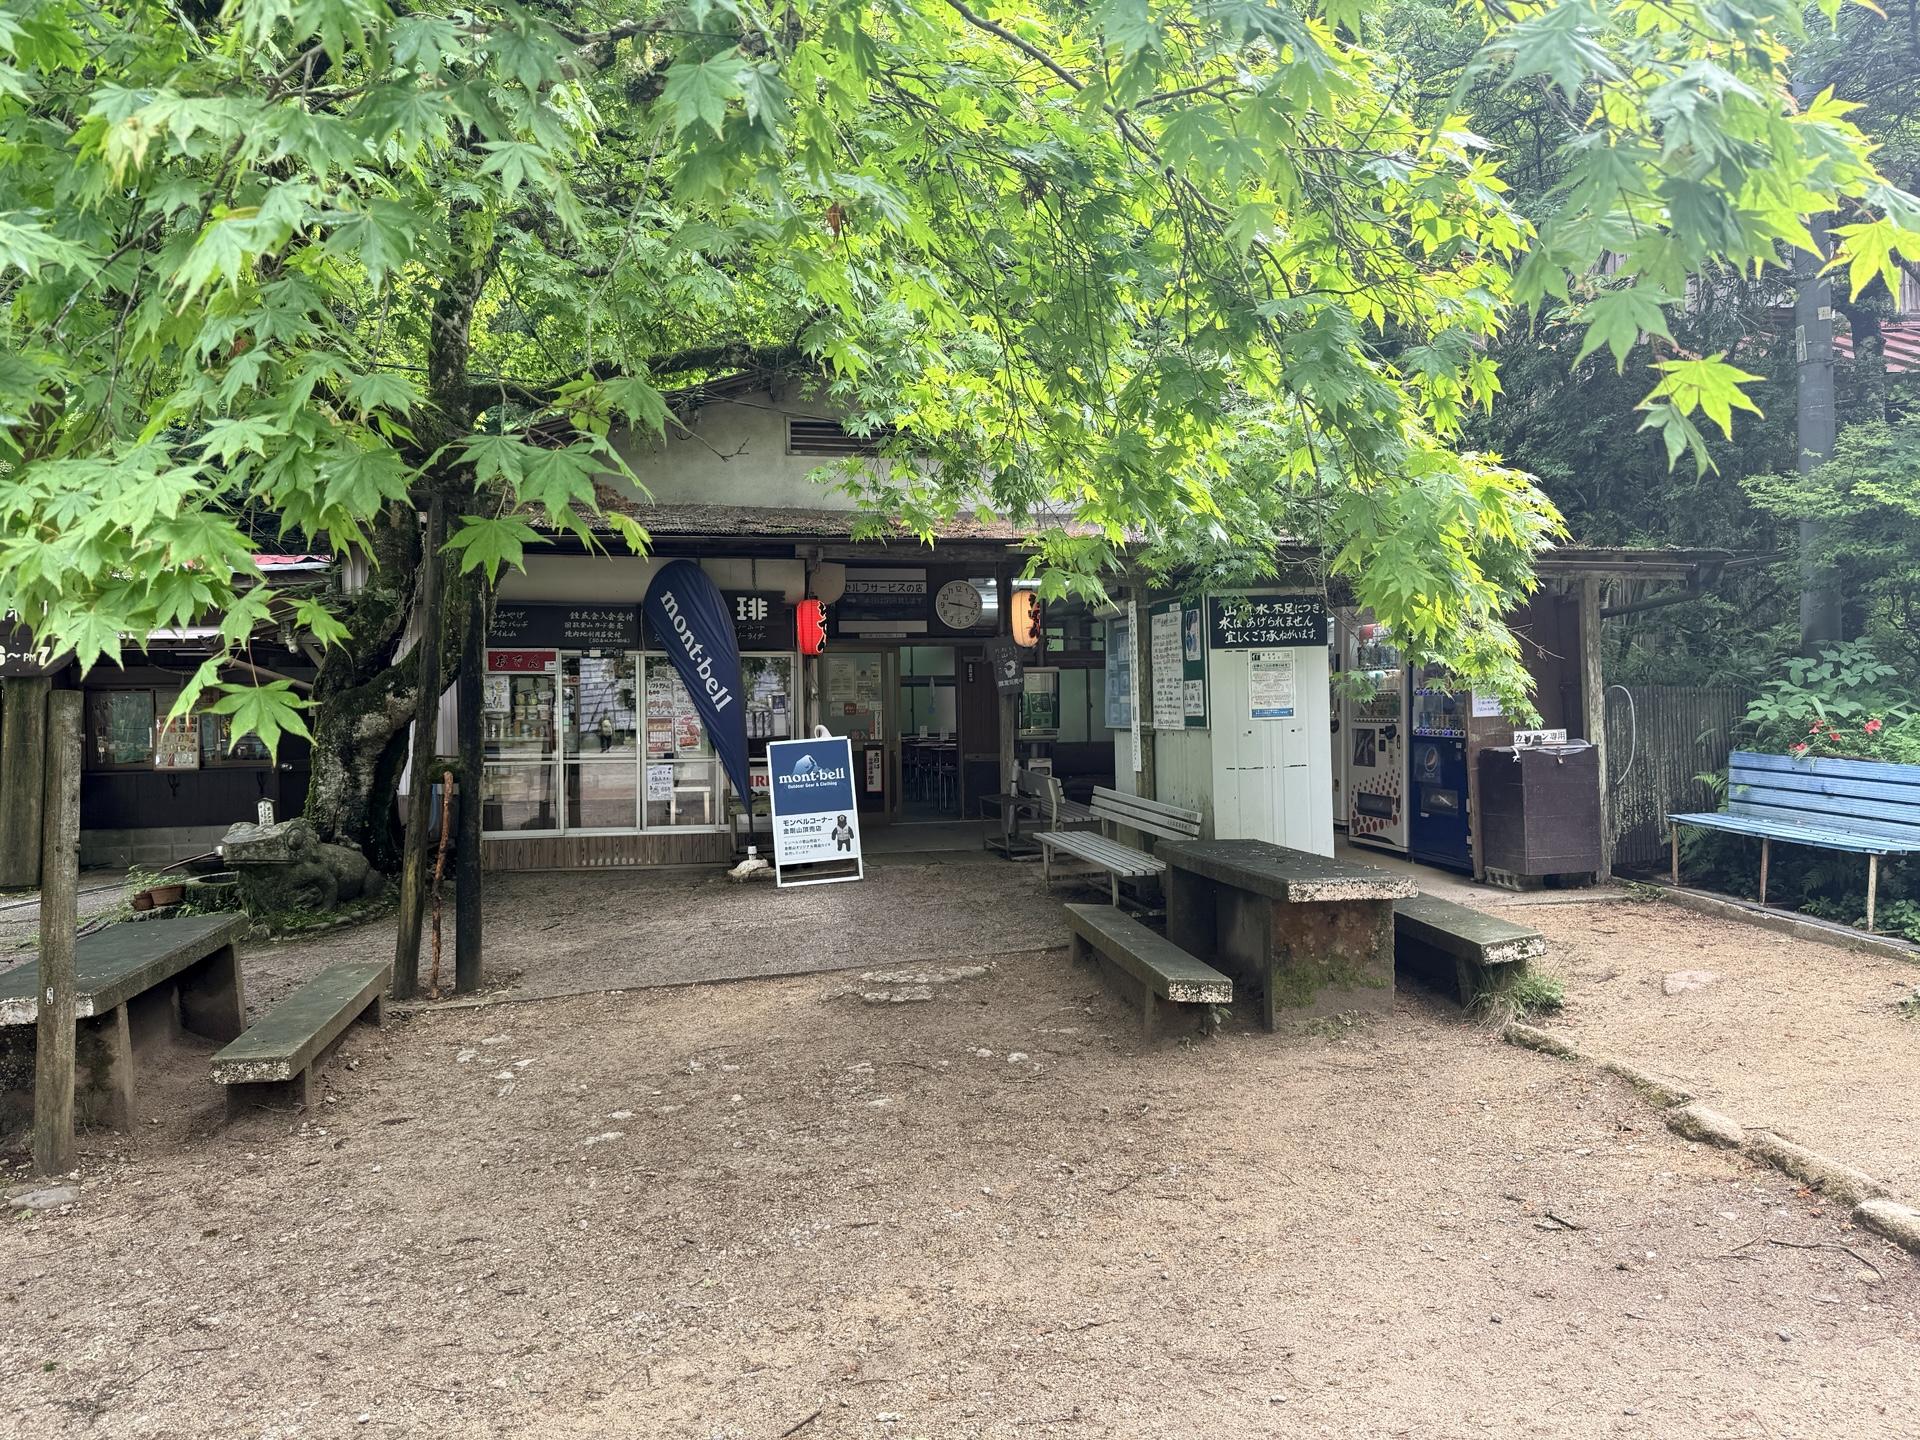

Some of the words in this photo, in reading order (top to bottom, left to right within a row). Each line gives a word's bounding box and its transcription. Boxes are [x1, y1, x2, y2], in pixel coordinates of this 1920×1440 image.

[782, 816, 833, 827] モンベルコーナー
[783, 825, 822, 835] 金剛山頂売店
